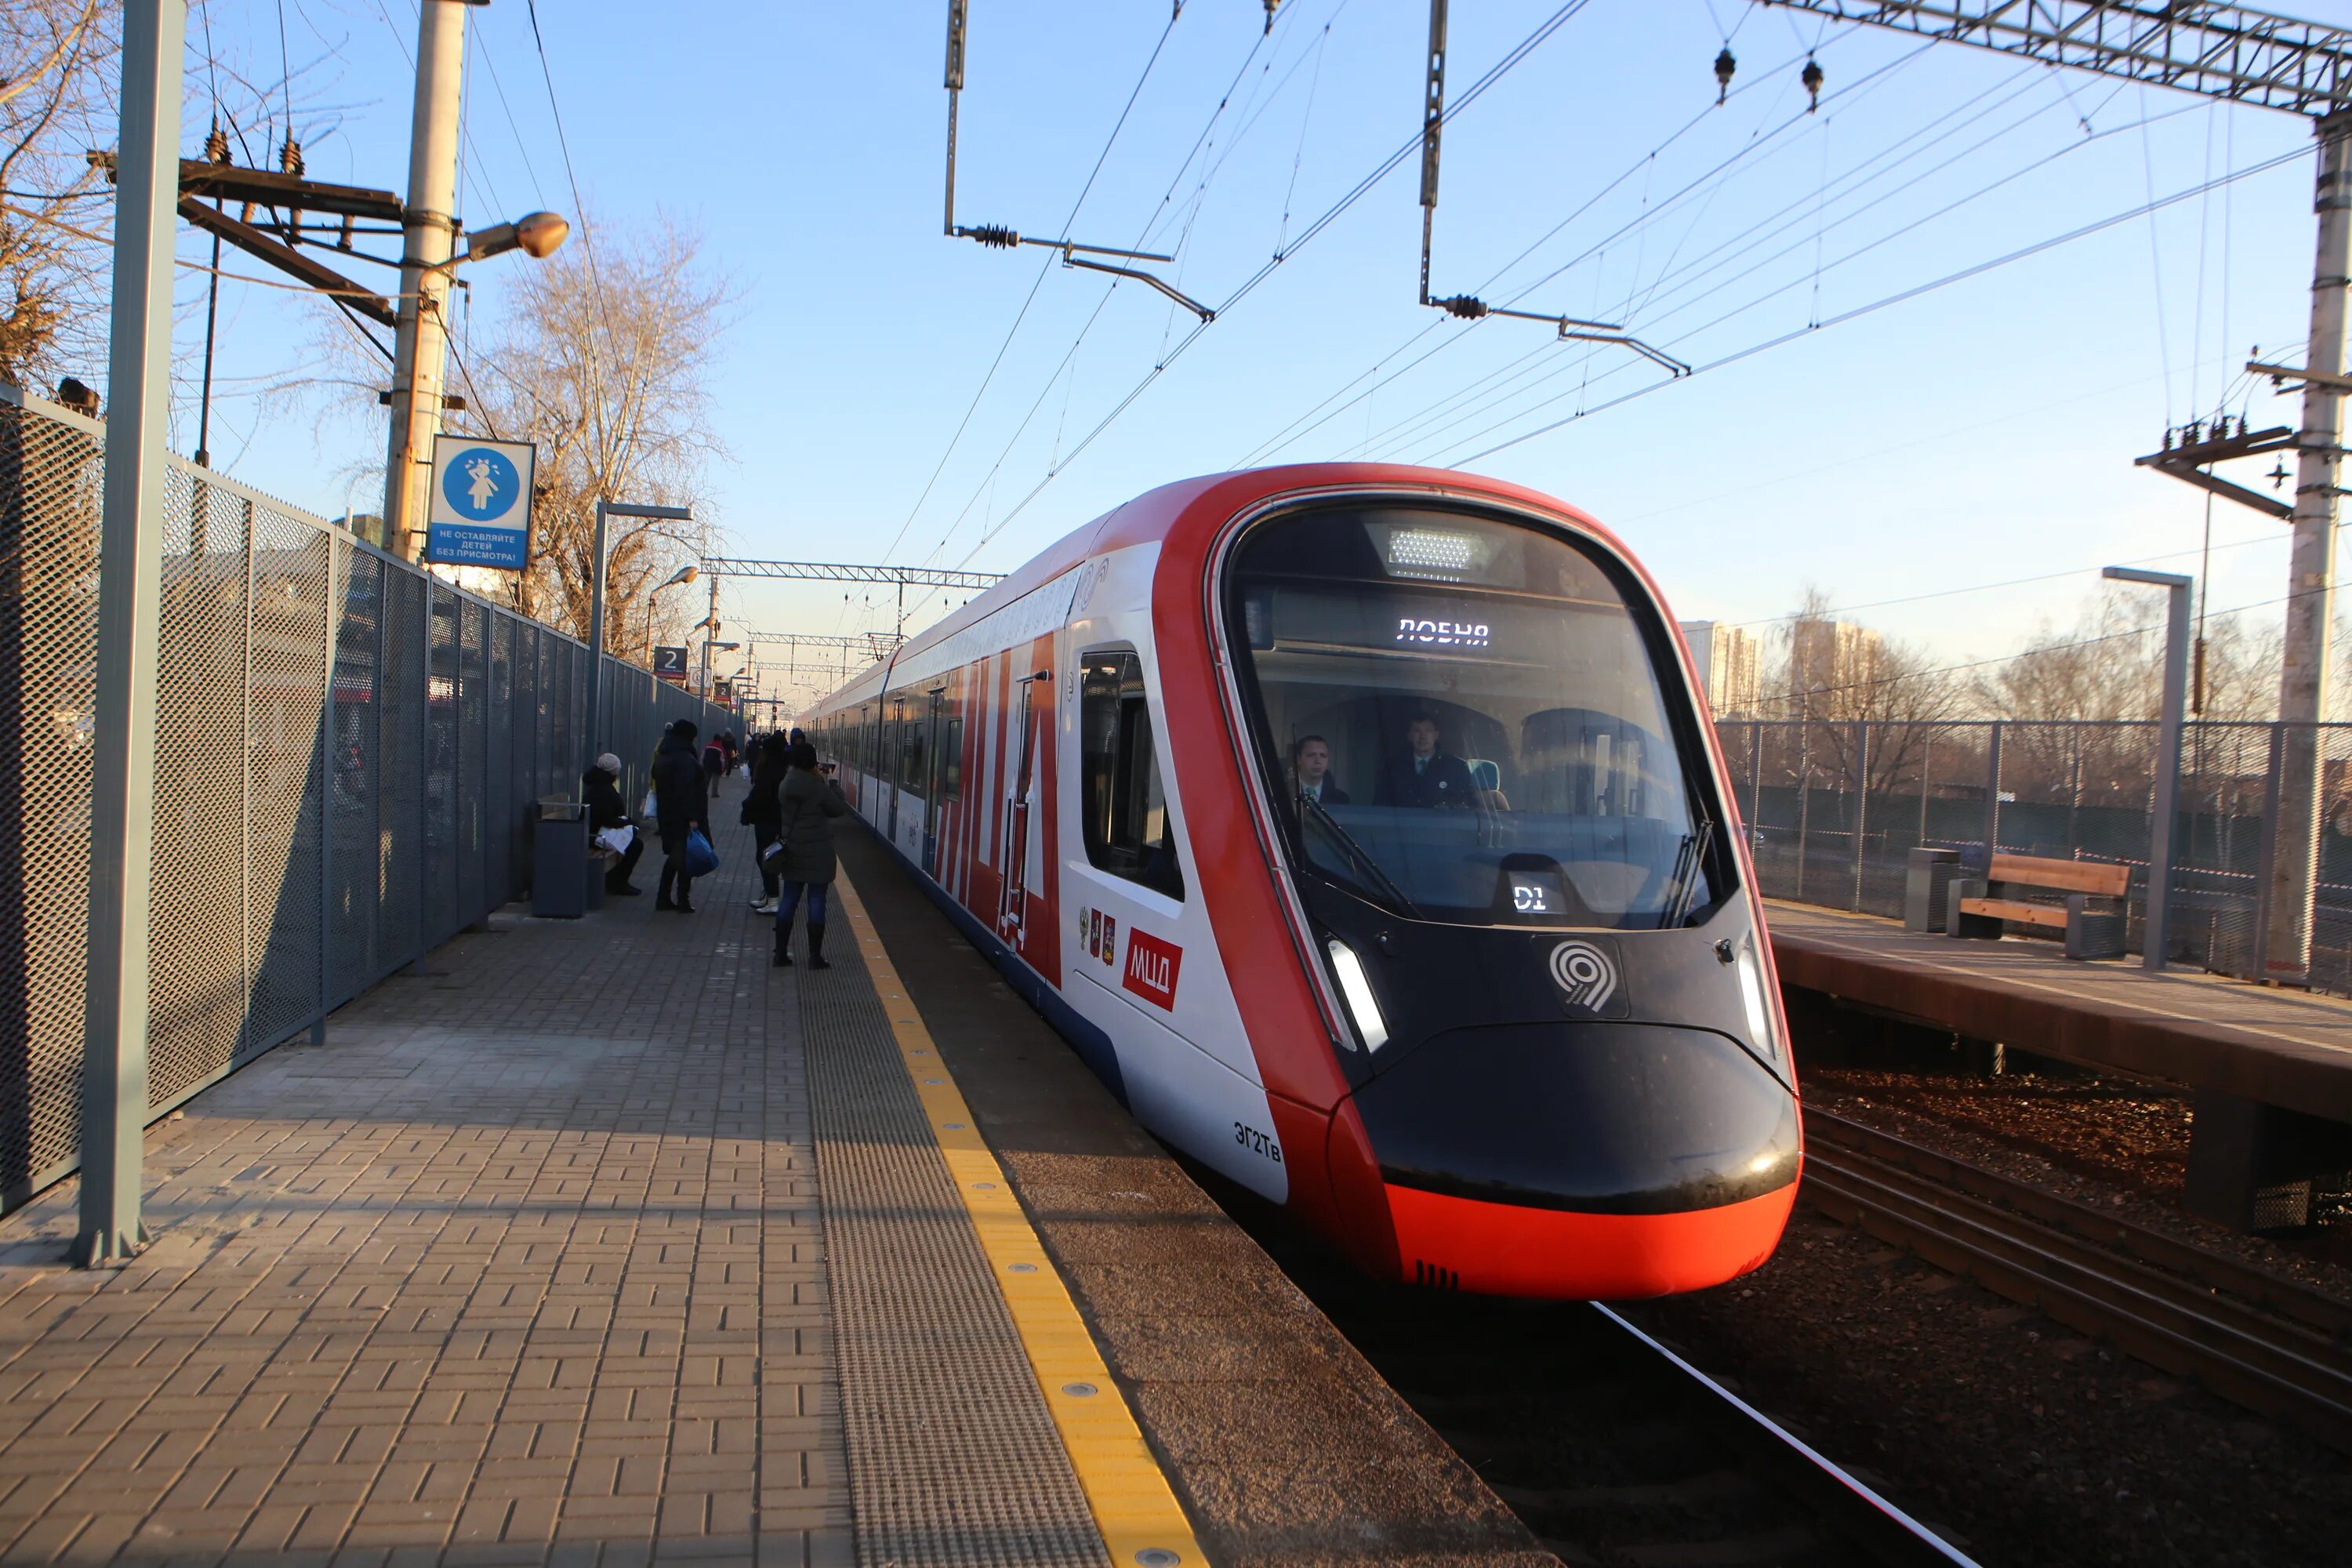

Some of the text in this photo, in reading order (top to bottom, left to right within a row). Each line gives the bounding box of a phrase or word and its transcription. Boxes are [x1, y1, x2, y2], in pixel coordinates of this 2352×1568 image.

[454, 531, 515, 543] ОСТАВЛЯЙТЕ
[461, 541, 492, 550] ДЕТЕЙ
[436, 547, 516, 561] БЕЗ ПРИСМОТРА!
[664, 650, 677, 669] 2
[1514, 886, 1546, 910] D1
[1130, 944, 1170, 994] МЦД
